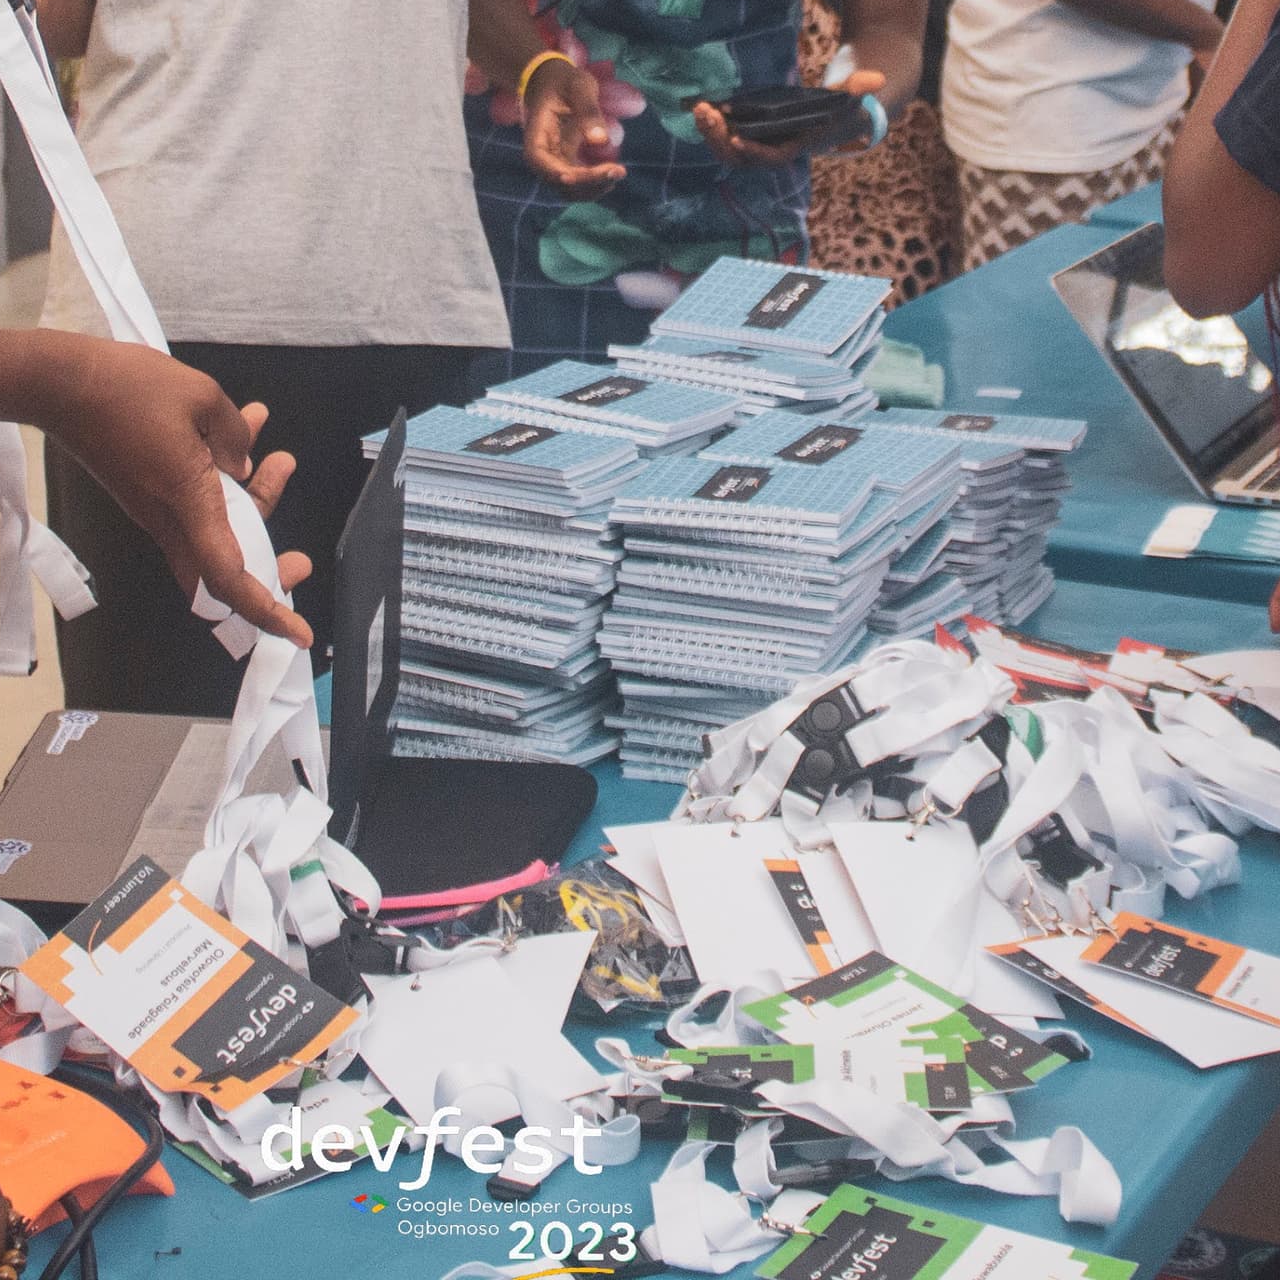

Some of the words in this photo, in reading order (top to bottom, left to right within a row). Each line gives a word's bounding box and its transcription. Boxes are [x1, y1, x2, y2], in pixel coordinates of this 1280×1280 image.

[103, 864, 156, 915] Volunteer
[159, 937, 214, 988] Marvellous
[840, 965, 869, 983] TEAM
[1143, 943, 1183, 979] devfest
[215, 982, 298, 1066] devfest
